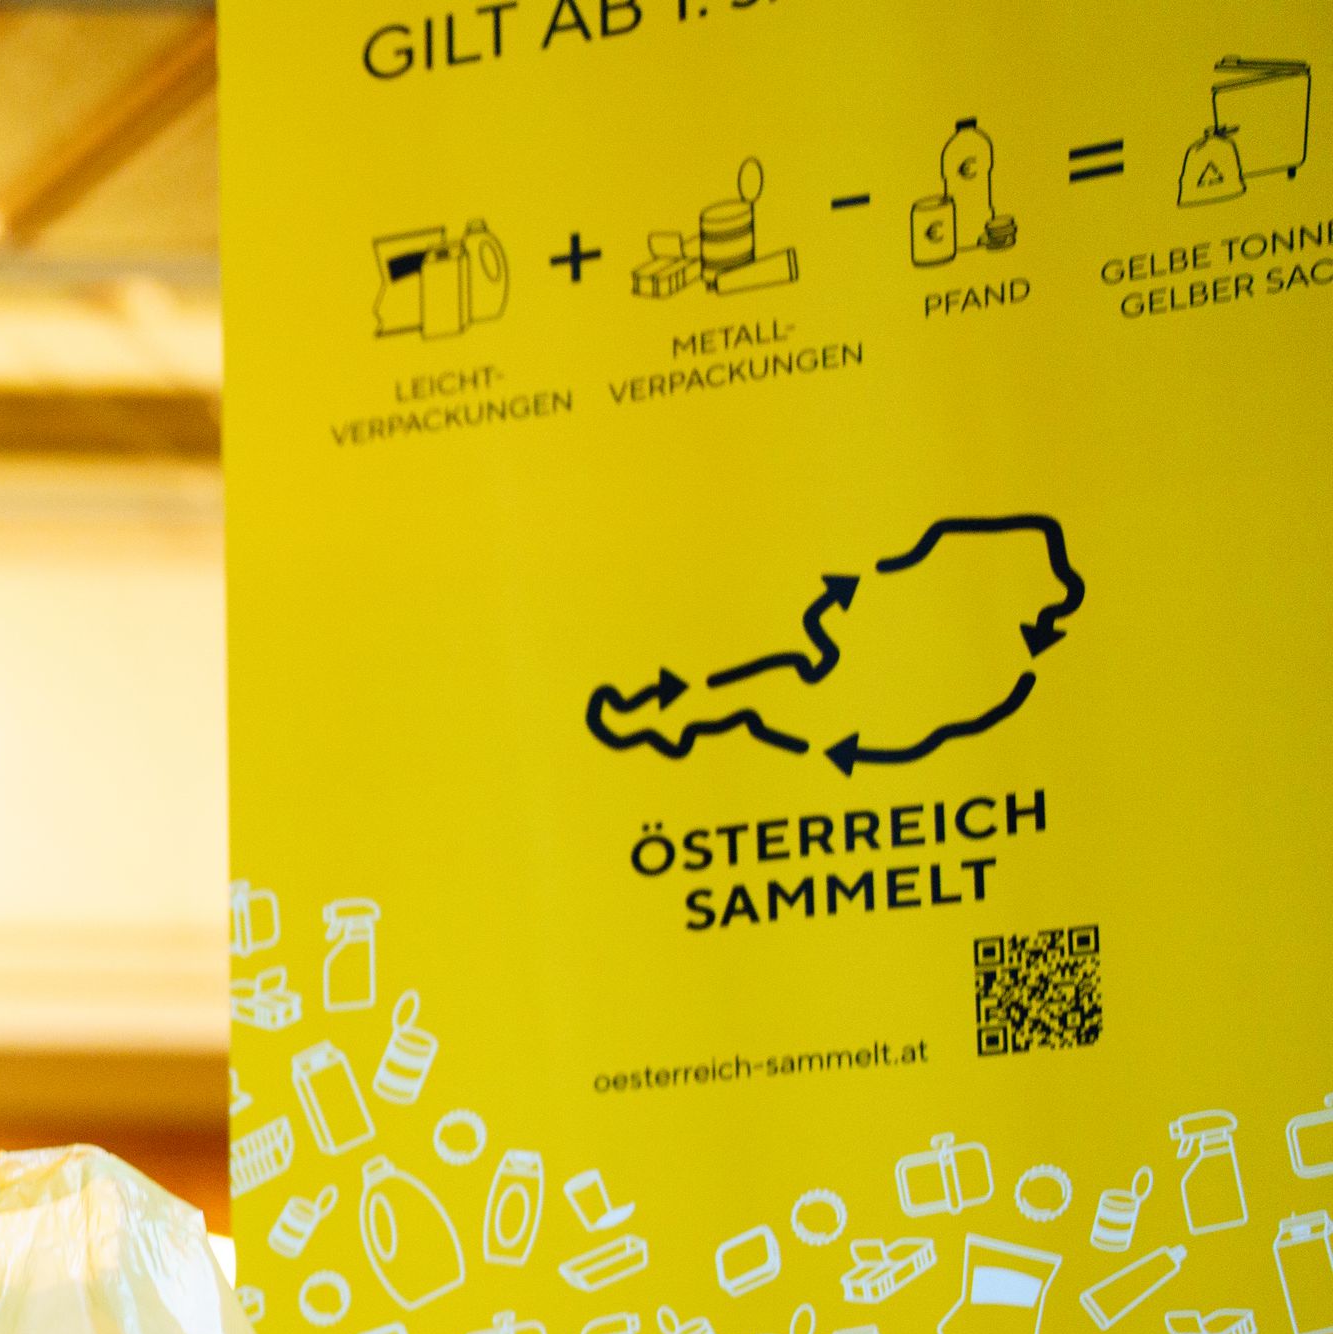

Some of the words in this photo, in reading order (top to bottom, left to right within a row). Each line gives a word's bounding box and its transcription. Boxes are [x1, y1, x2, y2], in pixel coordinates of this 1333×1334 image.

[362, 1, 519, 80] GILT
[541, 0, 643, 50] AB
[1100, 241, 1212, 286] GELBE
[1220, 219, 1333, 264] TONN
[924, 275, 1031, 319] PFAND
[1120, 271, 1254, 319] GELBER
[672, 319, 797, 359] METALL-
[395, 363, 505, 404] LEICHT-
[609, 341, 865, 405] VERPACKUNGEN
[331, 390, 574, 447] VERPACKUNGEN
[630, 788, 1047, 876] ÖSTERREICH
[684, 855, 997, 932] SAMMELT
[593, 1038, 930, 1095] oesterreich-sammelt.at
